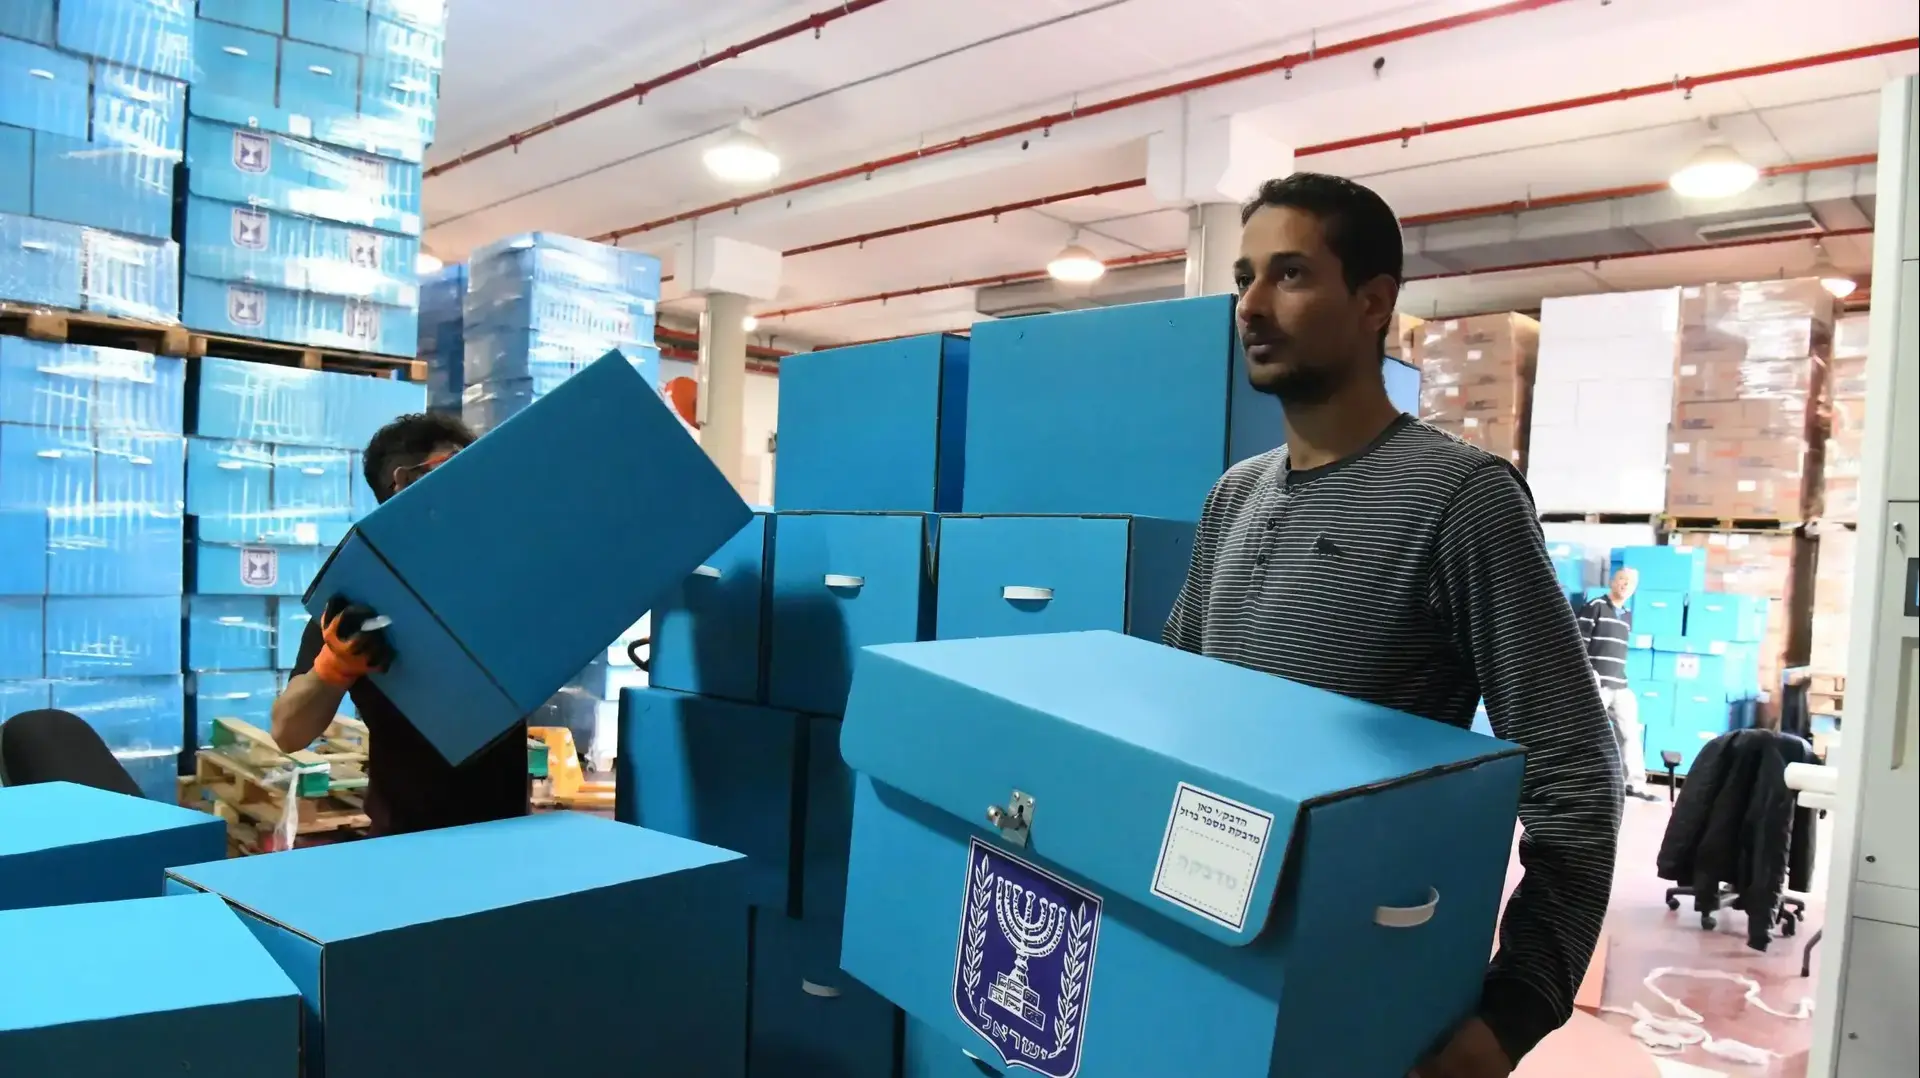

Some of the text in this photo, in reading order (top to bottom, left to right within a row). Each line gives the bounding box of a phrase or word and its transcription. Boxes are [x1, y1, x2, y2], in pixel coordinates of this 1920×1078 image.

[1180, 806, 1260, 844] מדבקת מספר ברזל
[1197, 803, 1247, 826] הדבק/י כאן
[1178, 855, 1237, 889] מדבקה
[979, 997, 1048, 1060] ישראל
